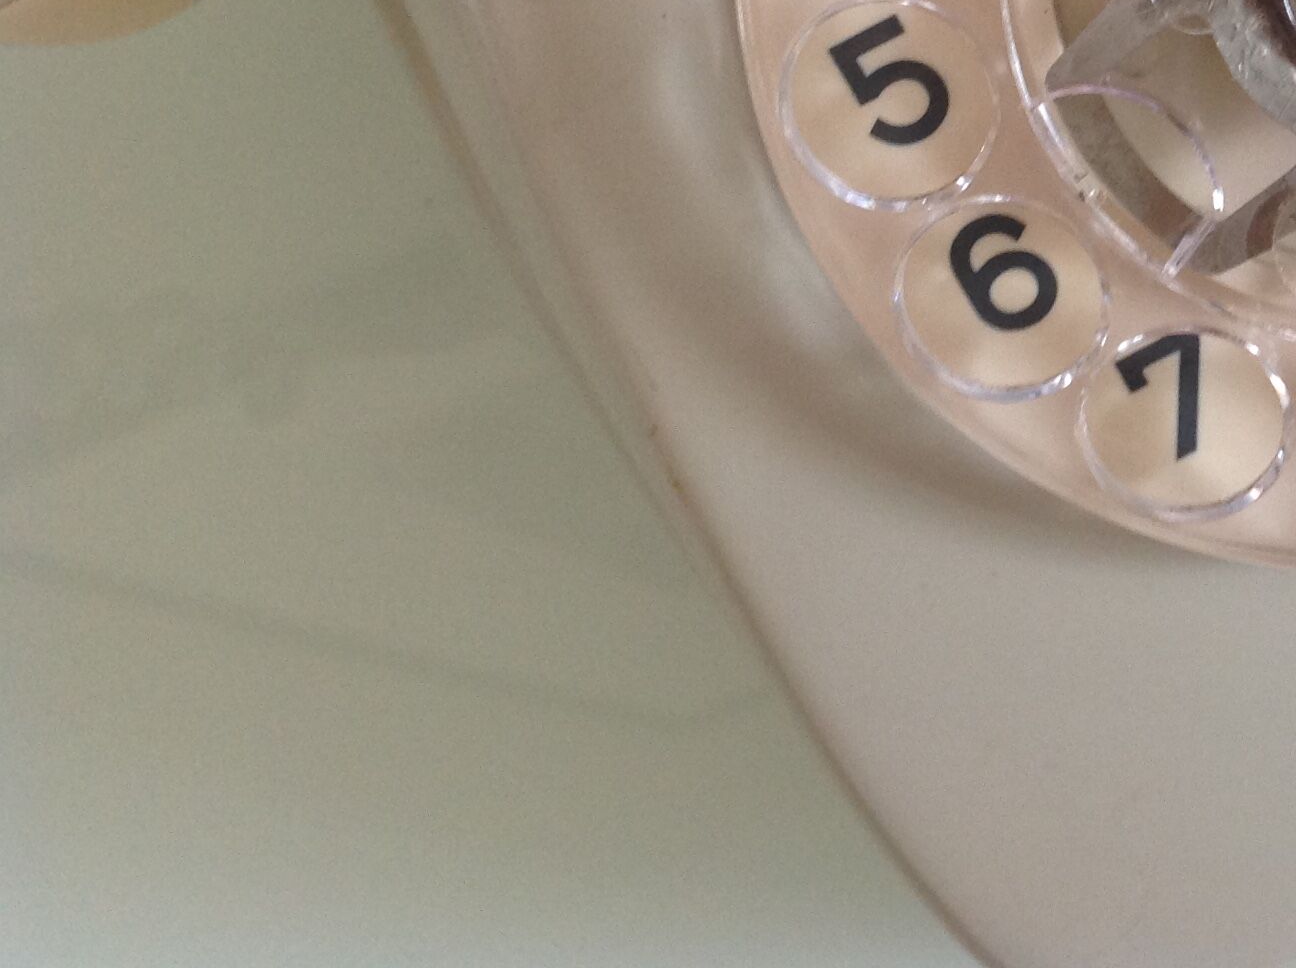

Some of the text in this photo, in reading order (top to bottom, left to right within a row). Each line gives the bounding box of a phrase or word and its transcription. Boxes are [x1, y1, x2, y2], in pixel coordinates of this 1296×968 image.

[827, 14, 951, 146] 5
[948, 212, 1059, 332] 6
[1114, 332, 1201, 461] 7
